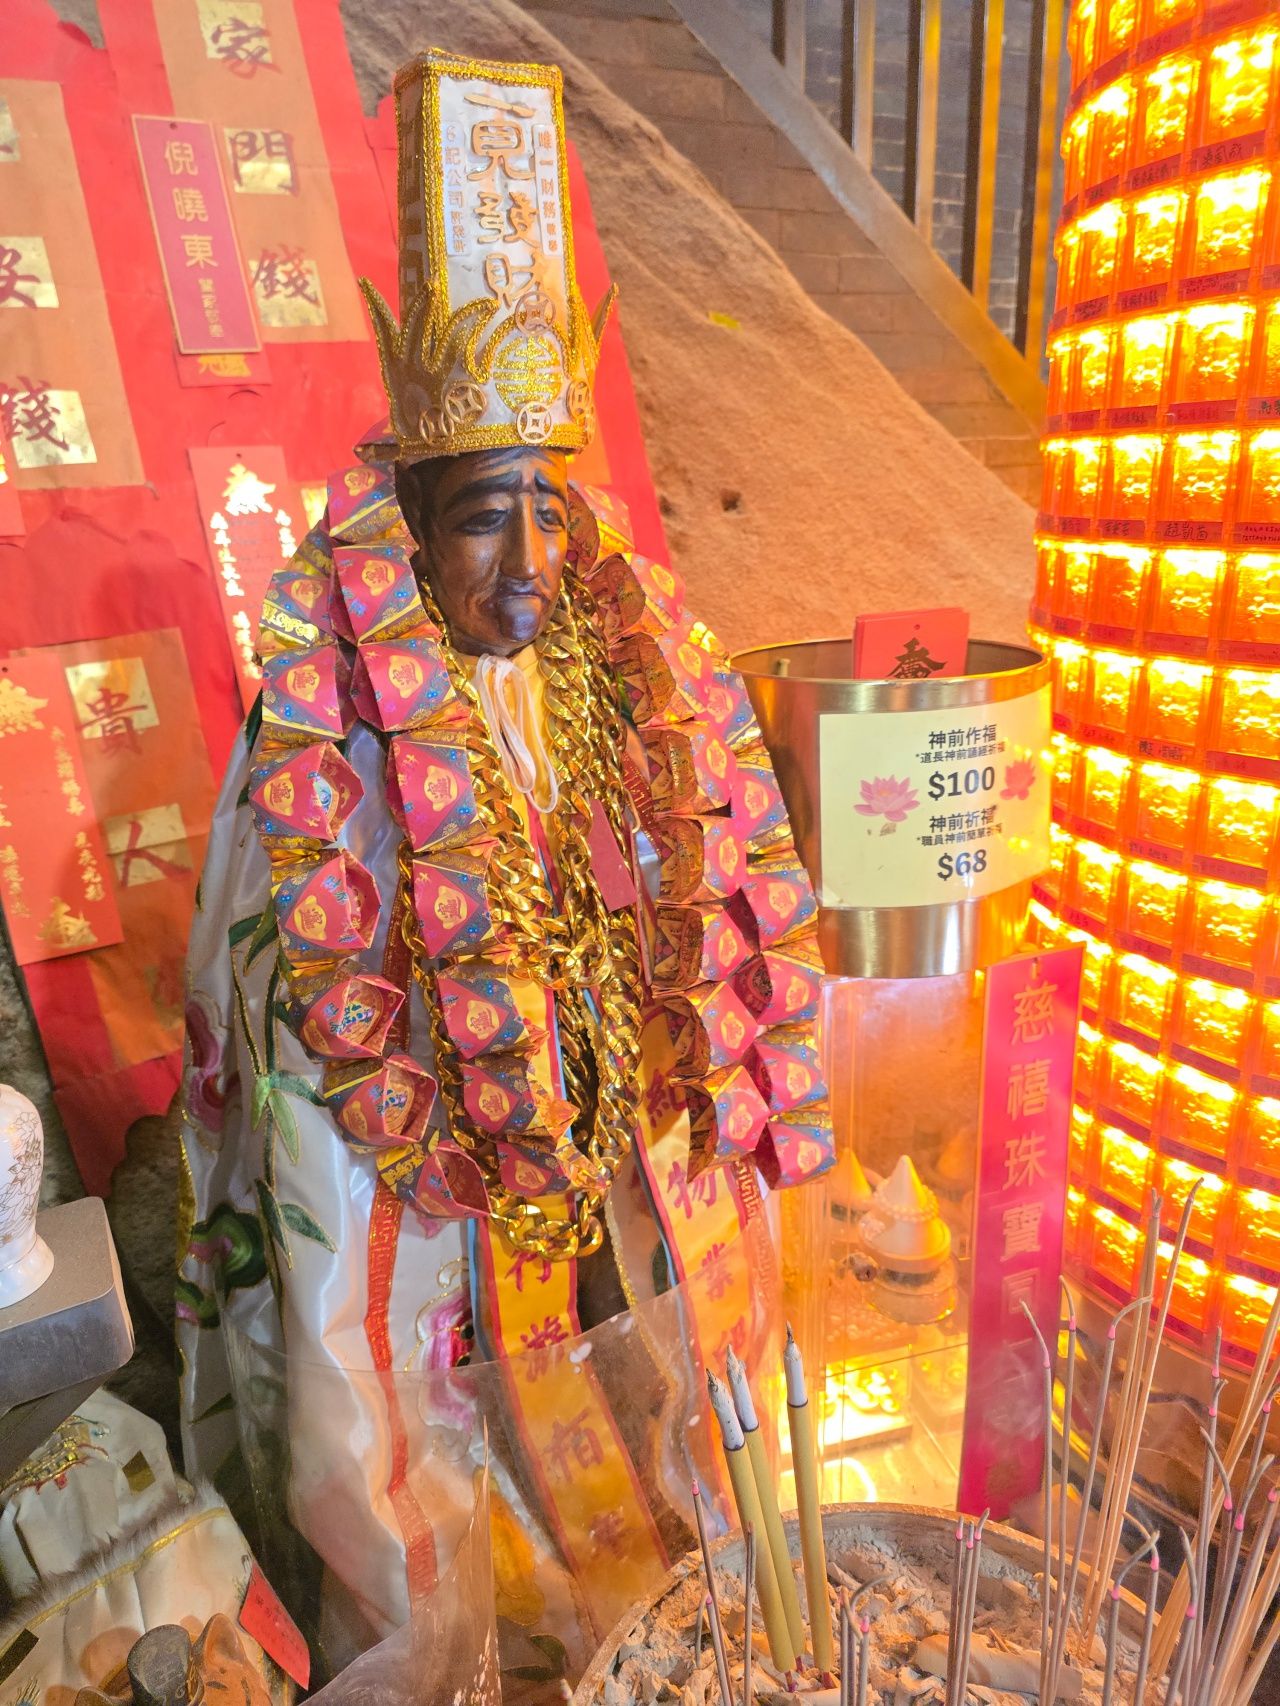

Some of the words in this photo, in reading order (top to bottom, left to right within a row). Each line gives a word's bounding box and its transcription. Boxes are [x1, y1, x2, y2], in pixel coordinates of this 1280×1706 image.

[164, 141, 218, 269] 倪曉東
[463, 92, 544, 310] 一見發財
[928, 723, 997, 750] 神前作福
[927, 766, 995, 801] $100
[929, 805, 997, 833] 神前祈福
[937, 849, 987, 881] $68
